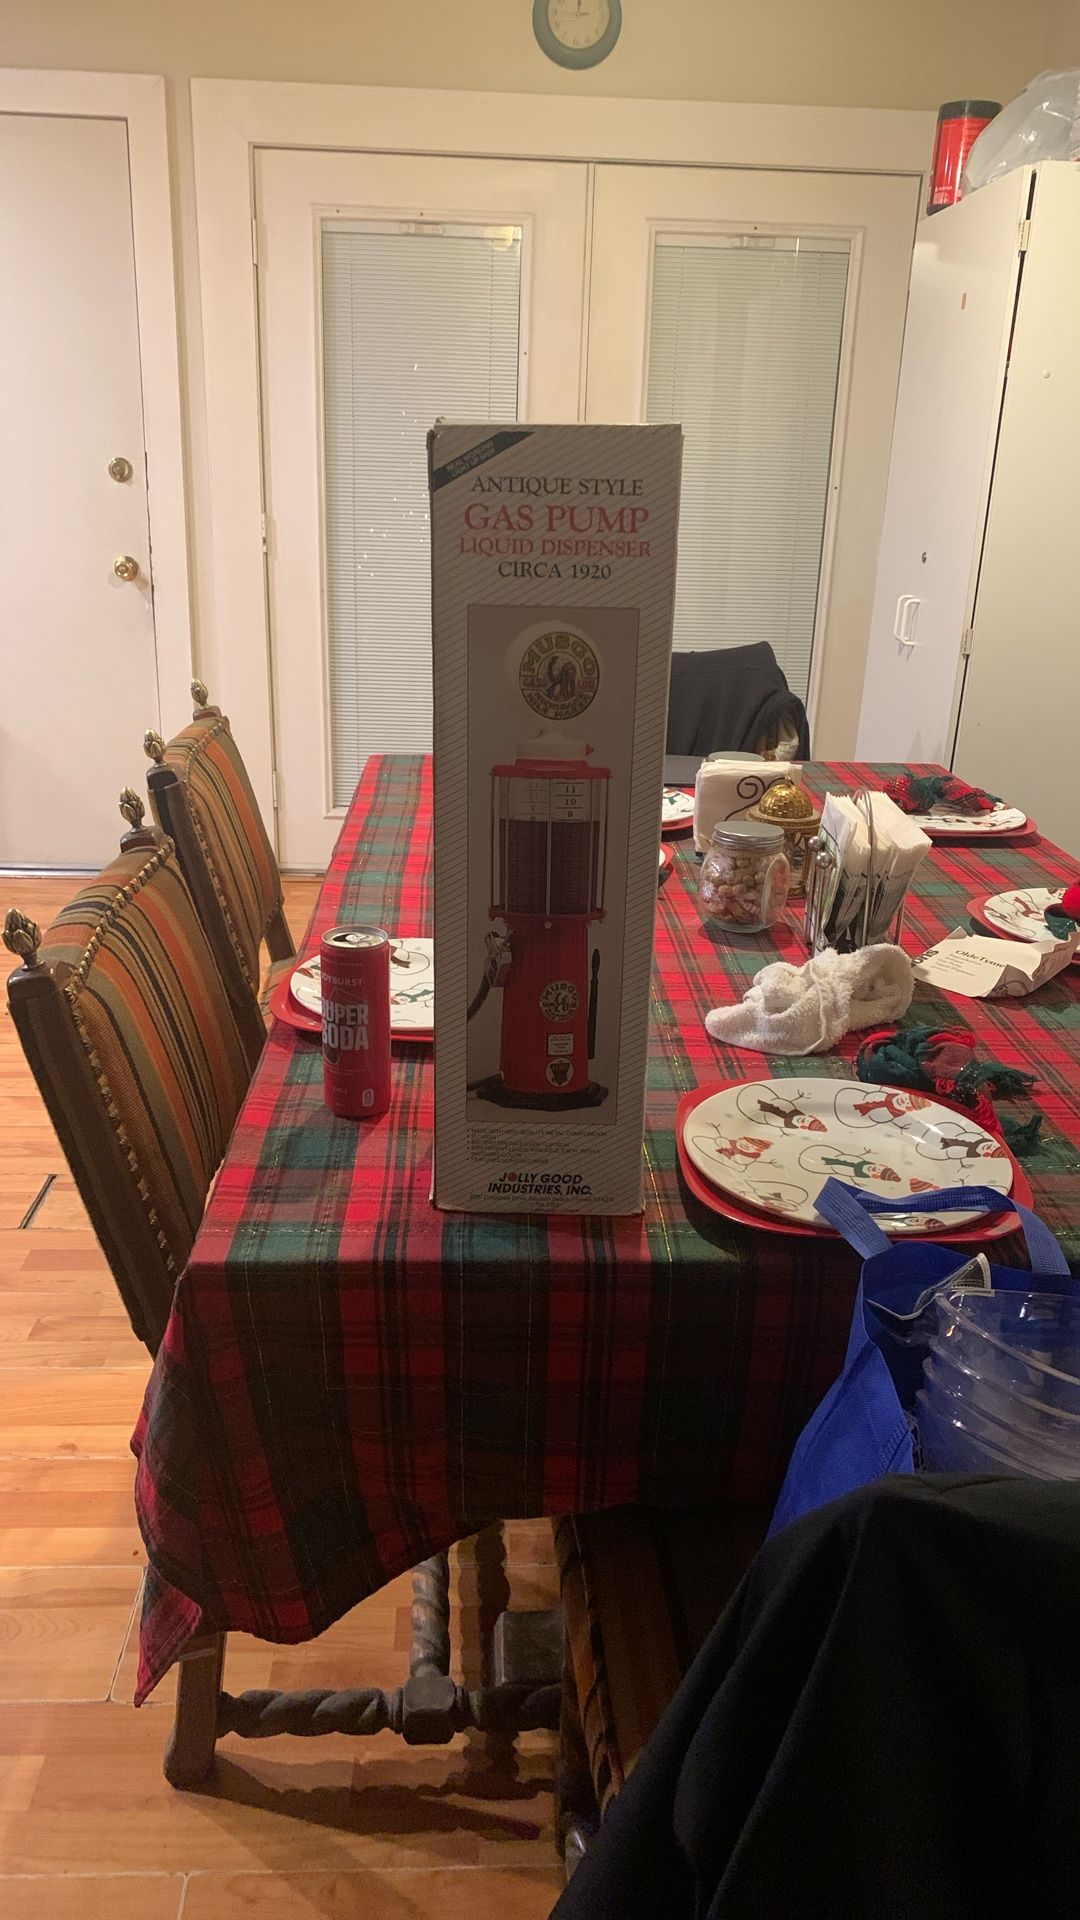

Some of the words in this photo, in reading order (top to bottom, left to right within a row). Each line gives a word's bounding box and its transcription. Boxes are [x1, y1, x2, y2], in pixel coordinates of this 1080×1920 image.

[471, 475, 571, 496] ANTIQUE
[579, 478, 644, 496] STYLE
[464, 503, 534, 531] GAS
[546, 505, 649, 534] PUMP
[459, 537, 533, 557] LIQUID
[541, 539, 651, 557] DISPENSER
[498, 562, 562, 579] CIRCA
[571, 563, 611, 580] 1920
[565, 785, 576, 793] 11
[564, 798, 577, 806] 10
[321, 971, 364, 987] OYBURST
[499, 1172, 538, 1183] JOLLY
[541, 1173, 582, 1184] GOOD
[487, 1182, 563, 1196] INDUSTRIES,
[566, 1184, 592, 1196] INC.
